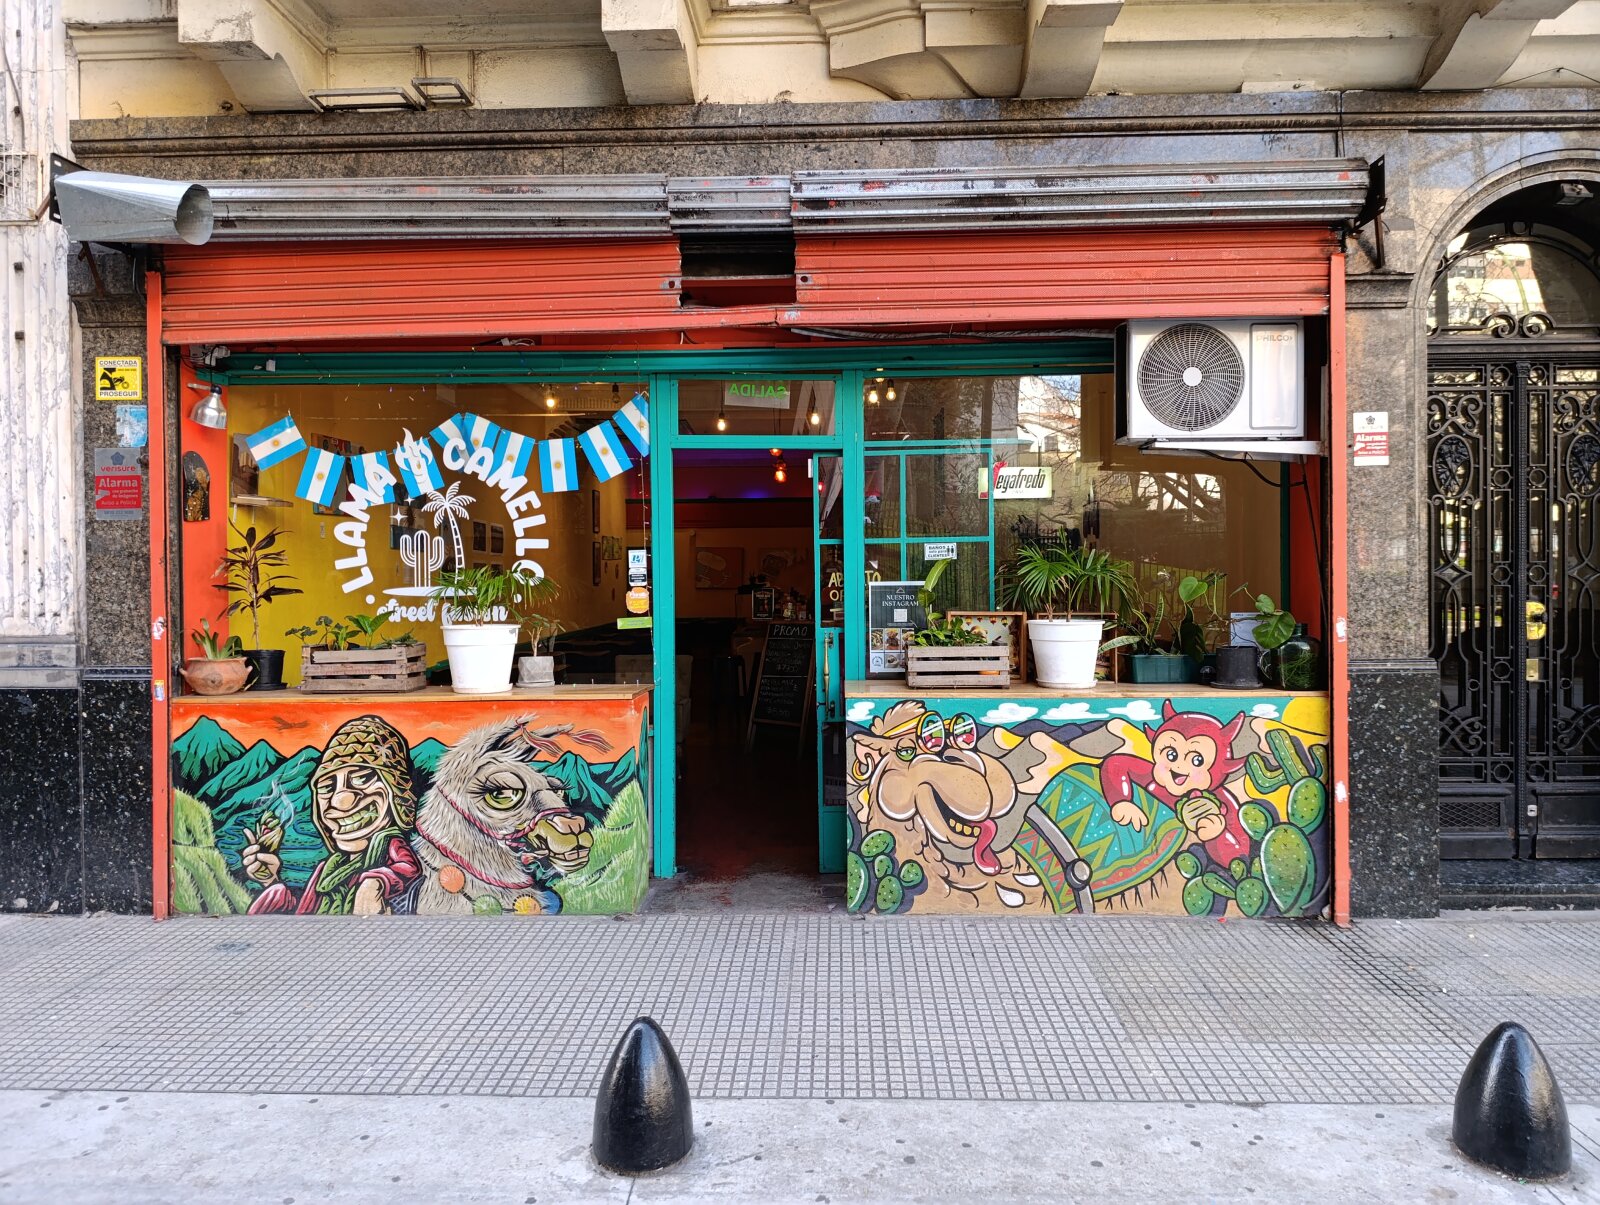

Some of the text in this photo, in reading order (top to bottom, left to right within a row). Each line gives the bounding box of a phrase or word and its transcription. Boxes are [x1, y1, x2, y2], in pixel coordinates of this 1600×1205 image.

[1256, 334, 1290, 342] PHILCO
[1355, 433, 1387, 442] Alarma
[98, 478, 138, 488] Alarma
[334, 438, 549, 593] LLAMA CAMELLO
[377, 598, 439, 623] street
[773, 625, 808, 636] PROMO
